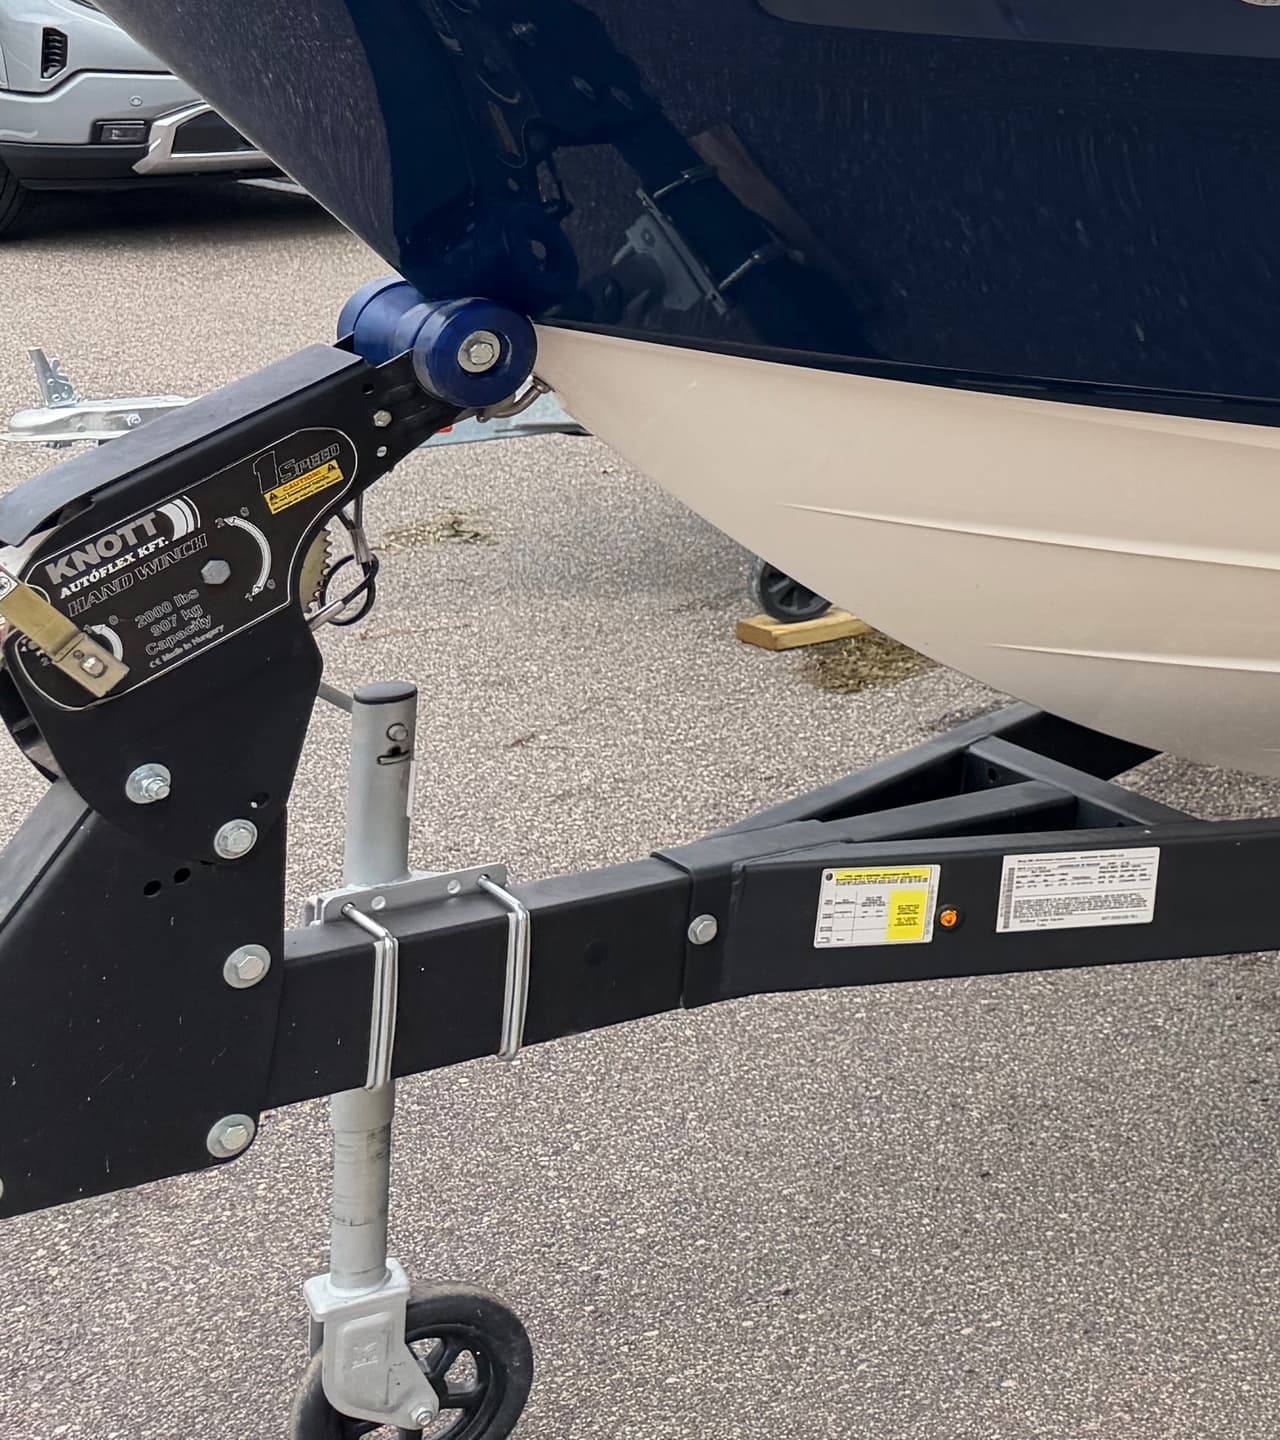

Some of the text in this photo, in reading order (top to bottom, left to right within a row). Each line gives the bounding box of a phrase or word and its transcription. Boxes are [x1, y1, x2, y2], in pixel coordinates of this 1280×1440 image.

[252, 450, 279, 494] 1
[45, 512, 158, 585] KNOTT
[60, 537, 169, 599] AUTÓFLEX KFT.
[68, 533, 208, 617] HAND WINCH
[135, 588, 199, 629] 2000 lbs
[150, 604, 204, 637] 907 kg
[145, 614, 211, 656] Capacity
